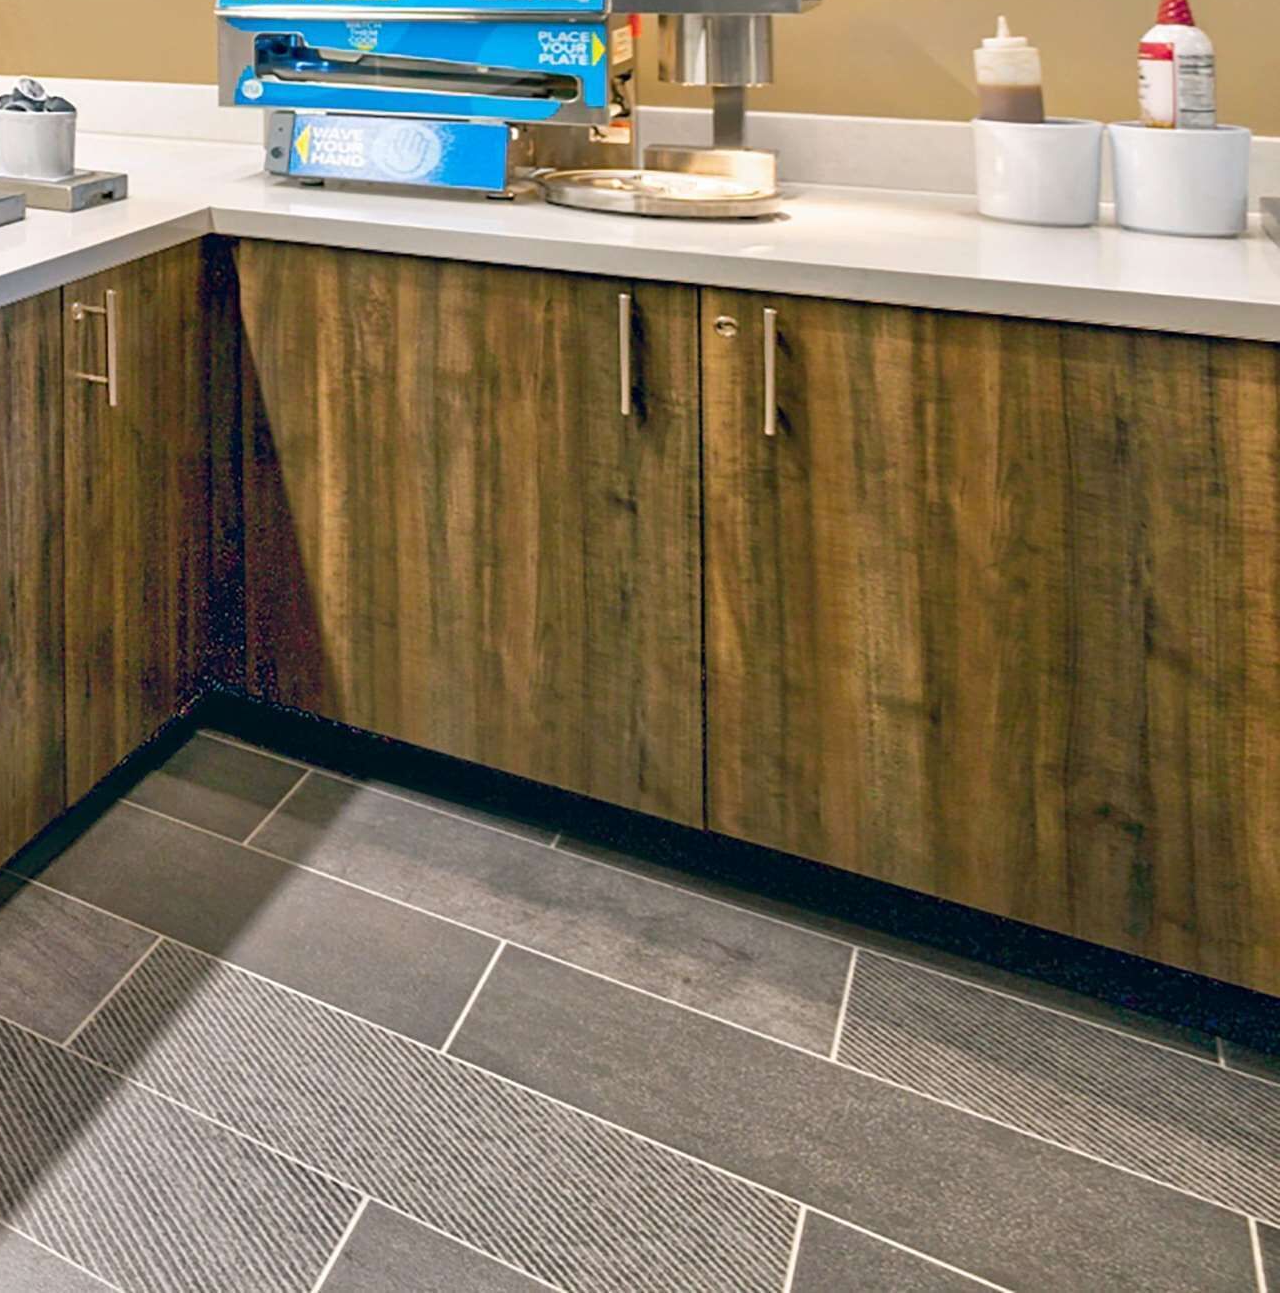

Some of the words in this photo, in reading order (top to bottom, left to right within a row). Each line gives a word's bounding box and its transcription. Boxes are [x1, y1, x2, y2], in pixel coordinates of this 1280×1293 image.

[538, 31, 590, 43] PLACE
[541, 43, 587, 54] YOUR
[538, 54, 590, 66] PLATE
[312, 126, 364, 140] WAVE
[313, 140, 364, 153] YOUR
[312, 153, 366, 167] HAND
